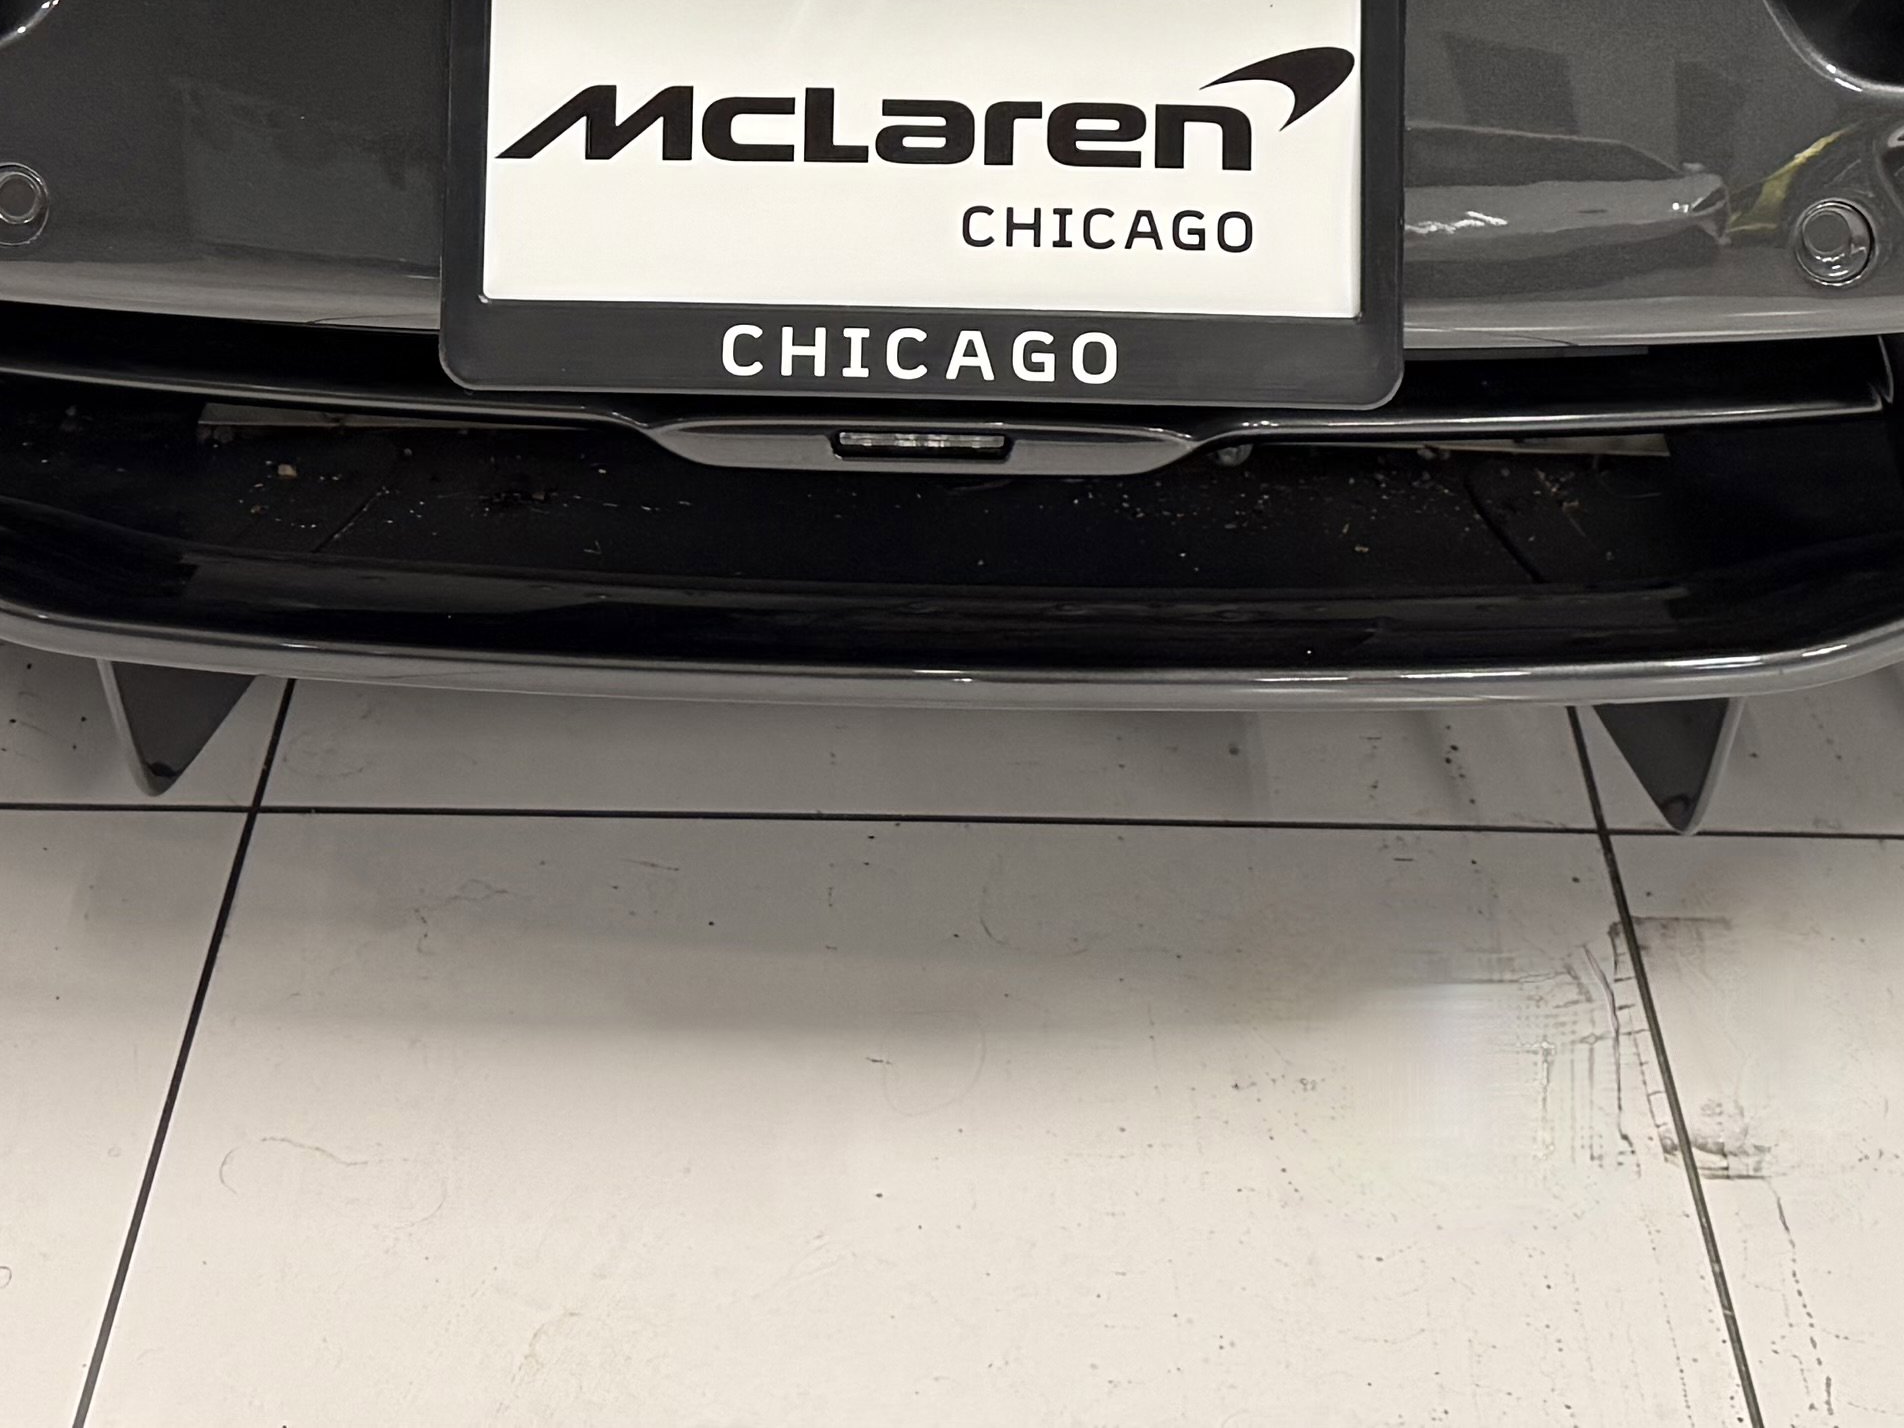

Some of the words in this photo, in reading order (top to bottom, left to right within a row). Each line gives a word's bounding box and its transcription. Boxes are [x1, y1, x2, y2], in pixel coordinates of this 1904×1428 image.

[496, 83, 1253, 172] McLaren
[960, 205, 1255, 254] CHICAGO
[720, 323, 1120, 386] CHICAGO
